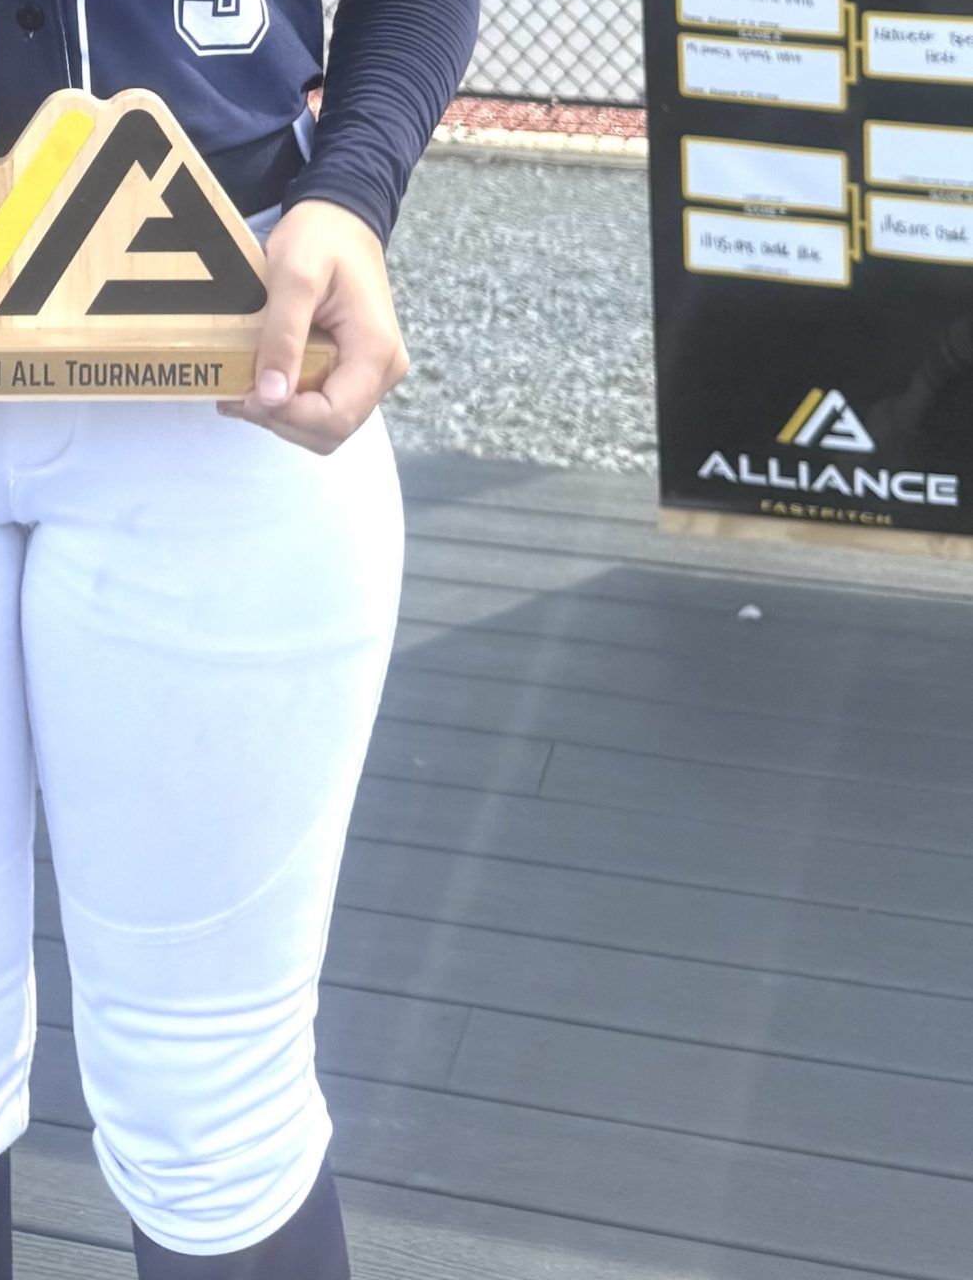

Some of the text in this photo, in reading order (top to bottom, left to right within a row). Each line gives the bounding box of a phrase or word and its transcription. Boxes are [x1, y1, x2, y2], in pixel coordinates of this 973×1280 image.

[11, 360, 55, 387] ALL
[65, 360, 223, 388] TOURNAMENT
[697, 450, 959, 506] ALLIANCE
[759, 498, 893, 526] FASTPITCH
